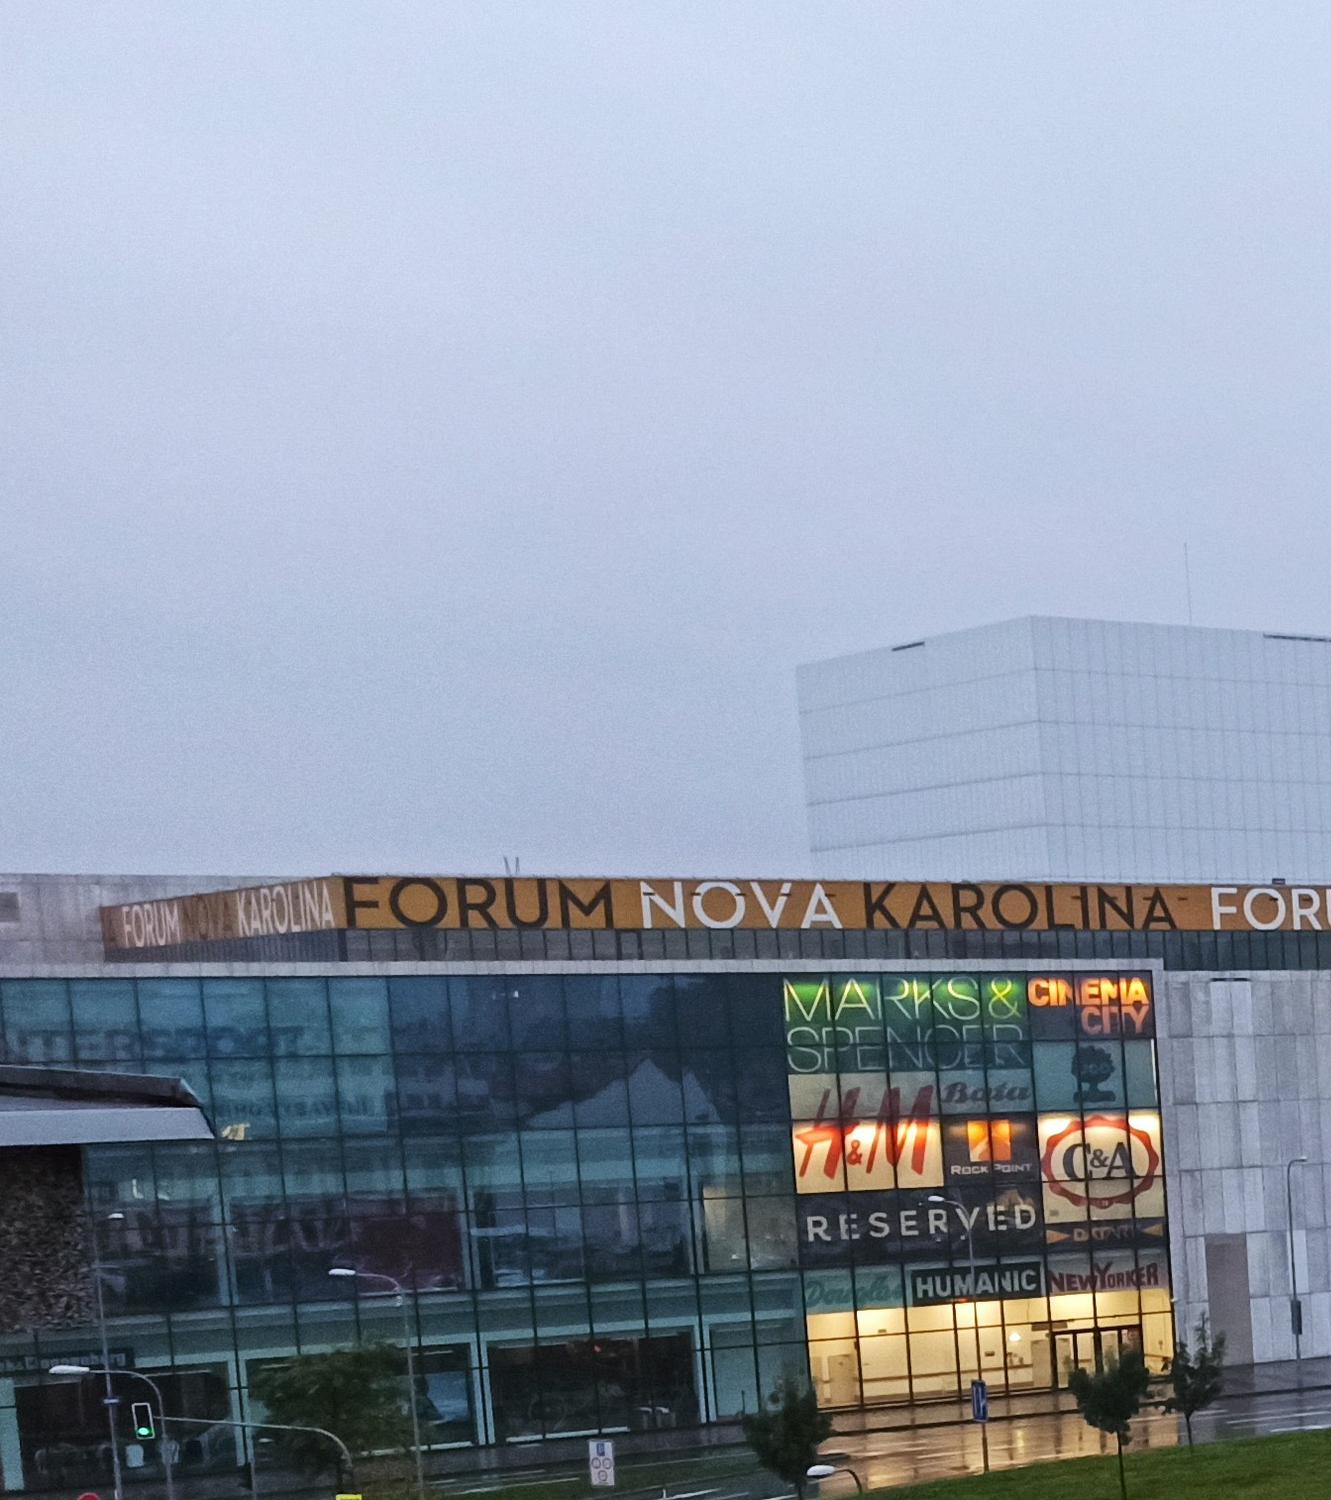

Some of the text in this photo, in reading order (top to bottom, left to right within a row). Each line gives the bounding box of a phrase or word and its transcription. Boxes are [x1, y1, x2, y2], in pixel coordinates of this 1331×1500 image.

[121, 900, 181, 948] FORUM
[236, 879, 336, 938] KAROLINA
[345, 878, 613, 930] FORUM
[641, 881, 842, 930] NOVA
[866, 881, 1178, 931] KAROLINA
[783, 976, 1022, 1023] MARKS &
[1027, 977, 1150, 1008] CINEMA
[1081, 1005, 1150, 1035] CITY
[788, 1023, 1026, 1074] SPENCER
[795, 1084, 935, 1180] H&M
[950, 1162, 1032, 1175] ROCK POINT
[1062, 1141, 1138, 1183] C&A
[806, 1203, 1037, 1243] RESERVED
[915, 1268, 1037, 1299] HUMANIC
